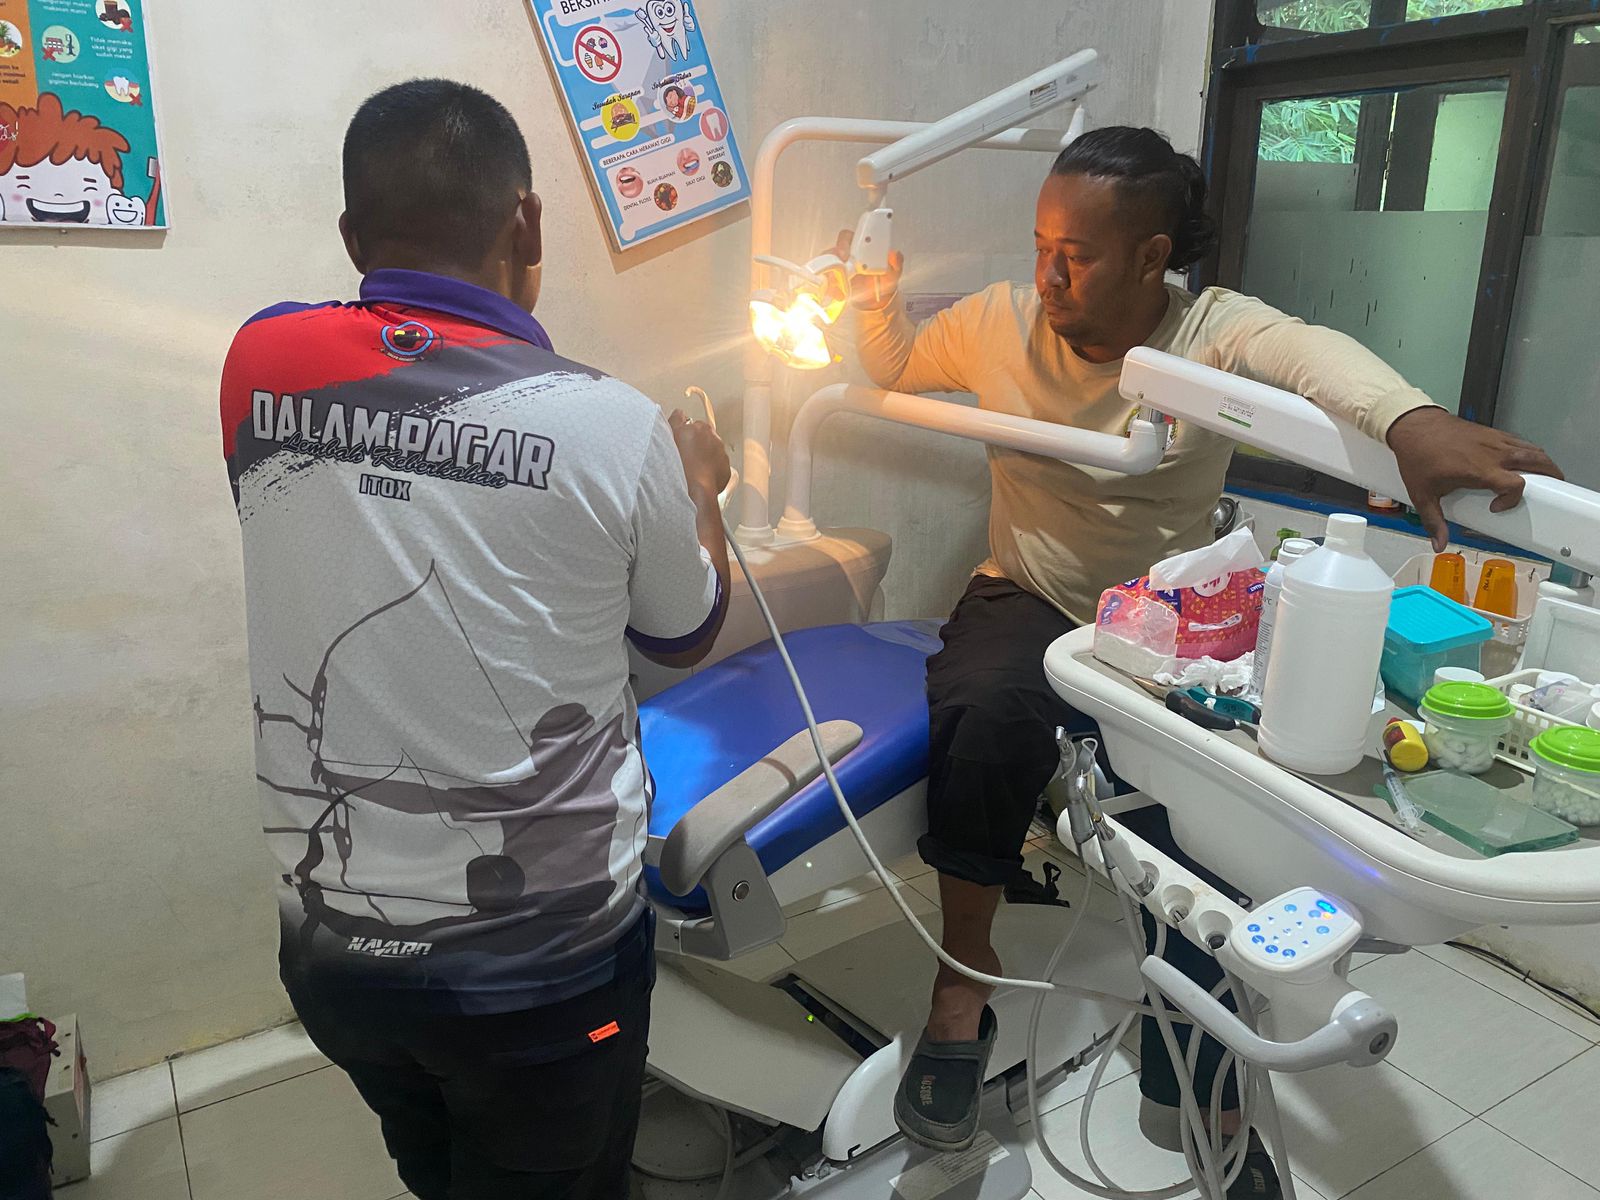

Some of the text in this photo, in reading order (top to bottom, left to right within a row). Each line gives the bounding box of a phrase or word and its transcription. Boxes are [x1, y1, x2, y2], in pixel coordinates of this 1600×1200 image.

[603, 136, 672, 166] BEBERAPA CARA MERAWAT GIGI
[623, 200, 639, 211] DENTAL
[252, 389, 555, 490] DALAM PAGAR
[280, 431, 508, 489] Lembah Keberkahan
[359, 474, 411, 501] ITOX
